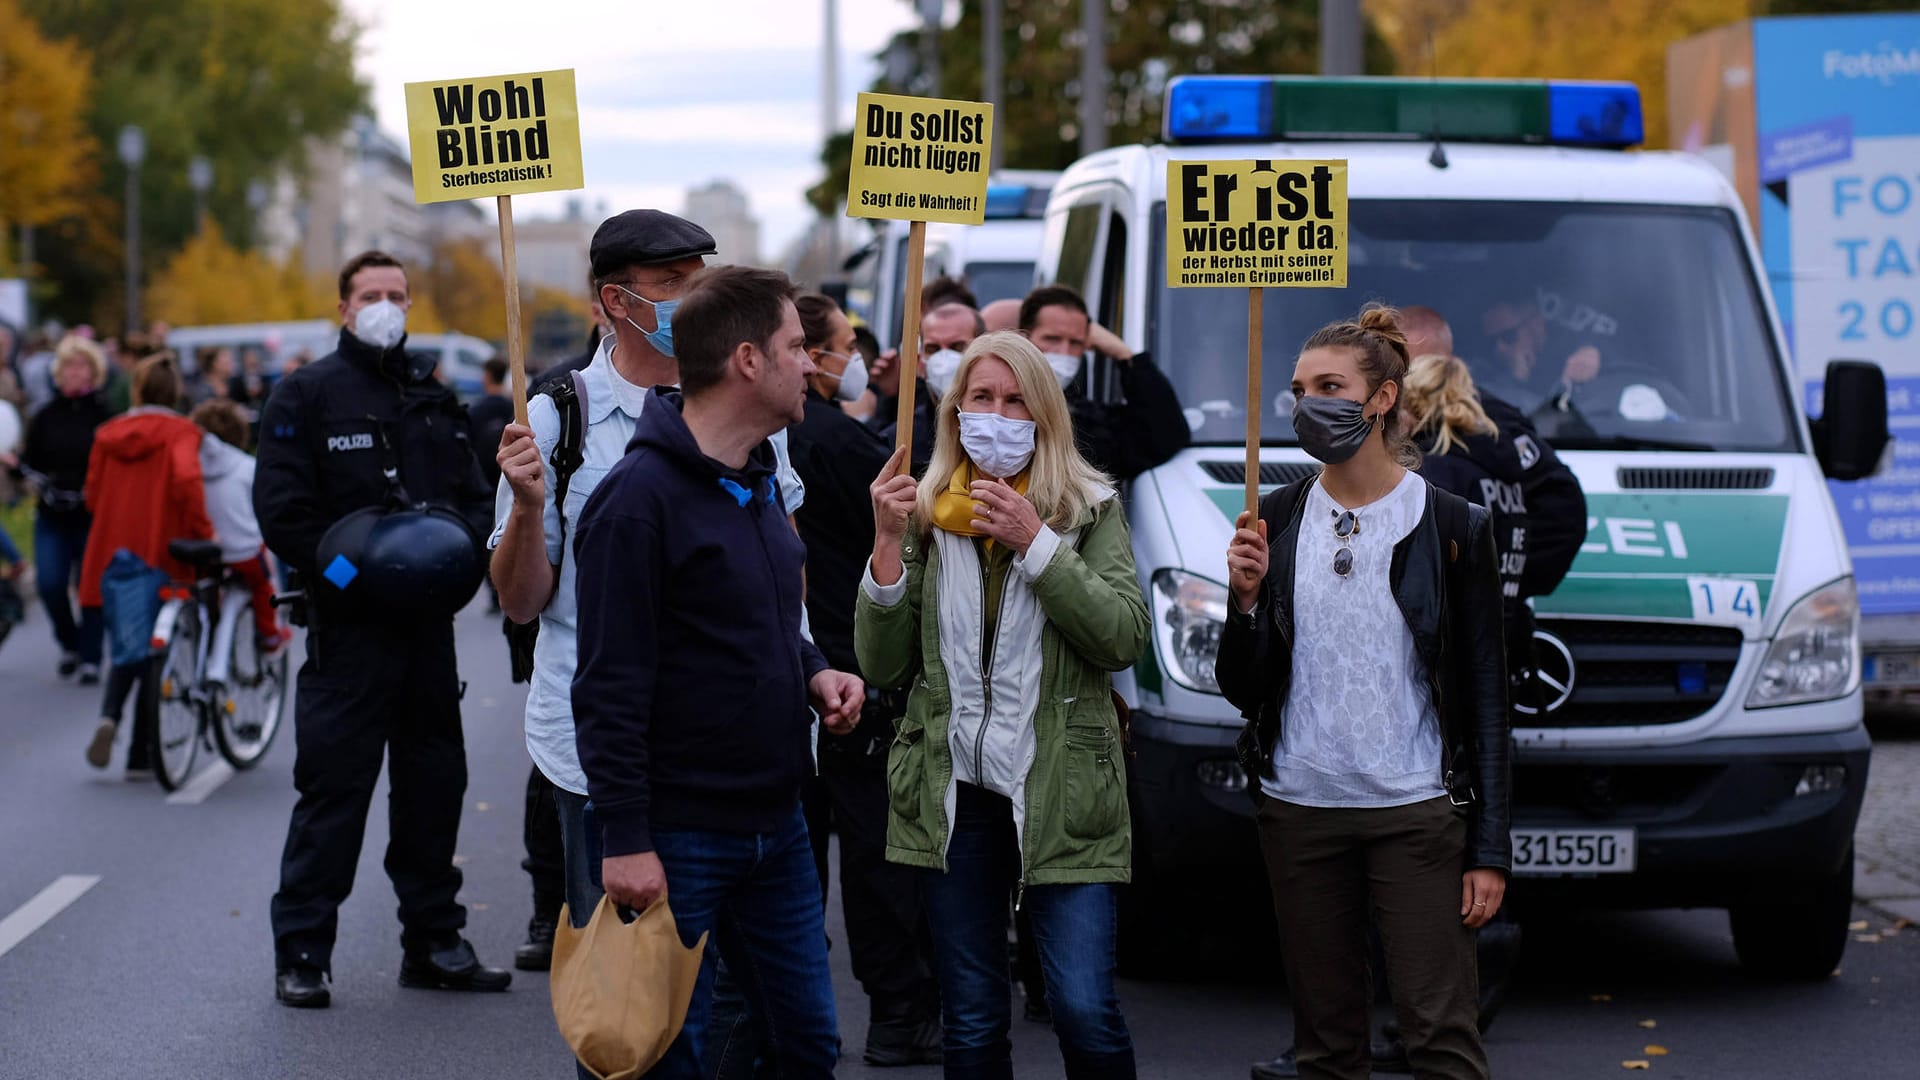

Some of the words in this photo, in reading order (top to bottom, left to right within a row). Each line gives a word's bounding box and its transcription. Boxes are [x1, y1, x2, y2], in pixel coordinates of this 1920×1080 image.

[433, 78, 546, 126] Wohl
[866, 104, 902, 139] Du
[910, 109, 983, 144] sollst
[437, 120, 549, 169] Blind
[864, 142, 921, 168] nicht
[926, 145, 980, 174] lügen
[442, 165, 545, 188] Sterbestatistik
[1182, 164, 1237, 222] Er
[1251, 160, 1334, 221] ist
[861, 190, 892, 208] Sagt
[895, 192, 916, 208] die
[919, 193, 971, 211] Wahrheit
[1832, 174, 1920, 217] FO
[1182, 222, 1289, 252] wieder
[1297, 220, 1338, 250] da,
[1182, 256, 1206, 269] der
[1210, 255, 1257, 269] Herbst
[1261, 255, 1284, 268] mit
[1288, 254, 1334, 267] seiner
[1834, 237, 1920, 279] TA
[1181, 270, 1246, 284] normalen
[1249, 269, 1335, 283] Grippewelle!
[1513, 835, 1617, 866] 31550
